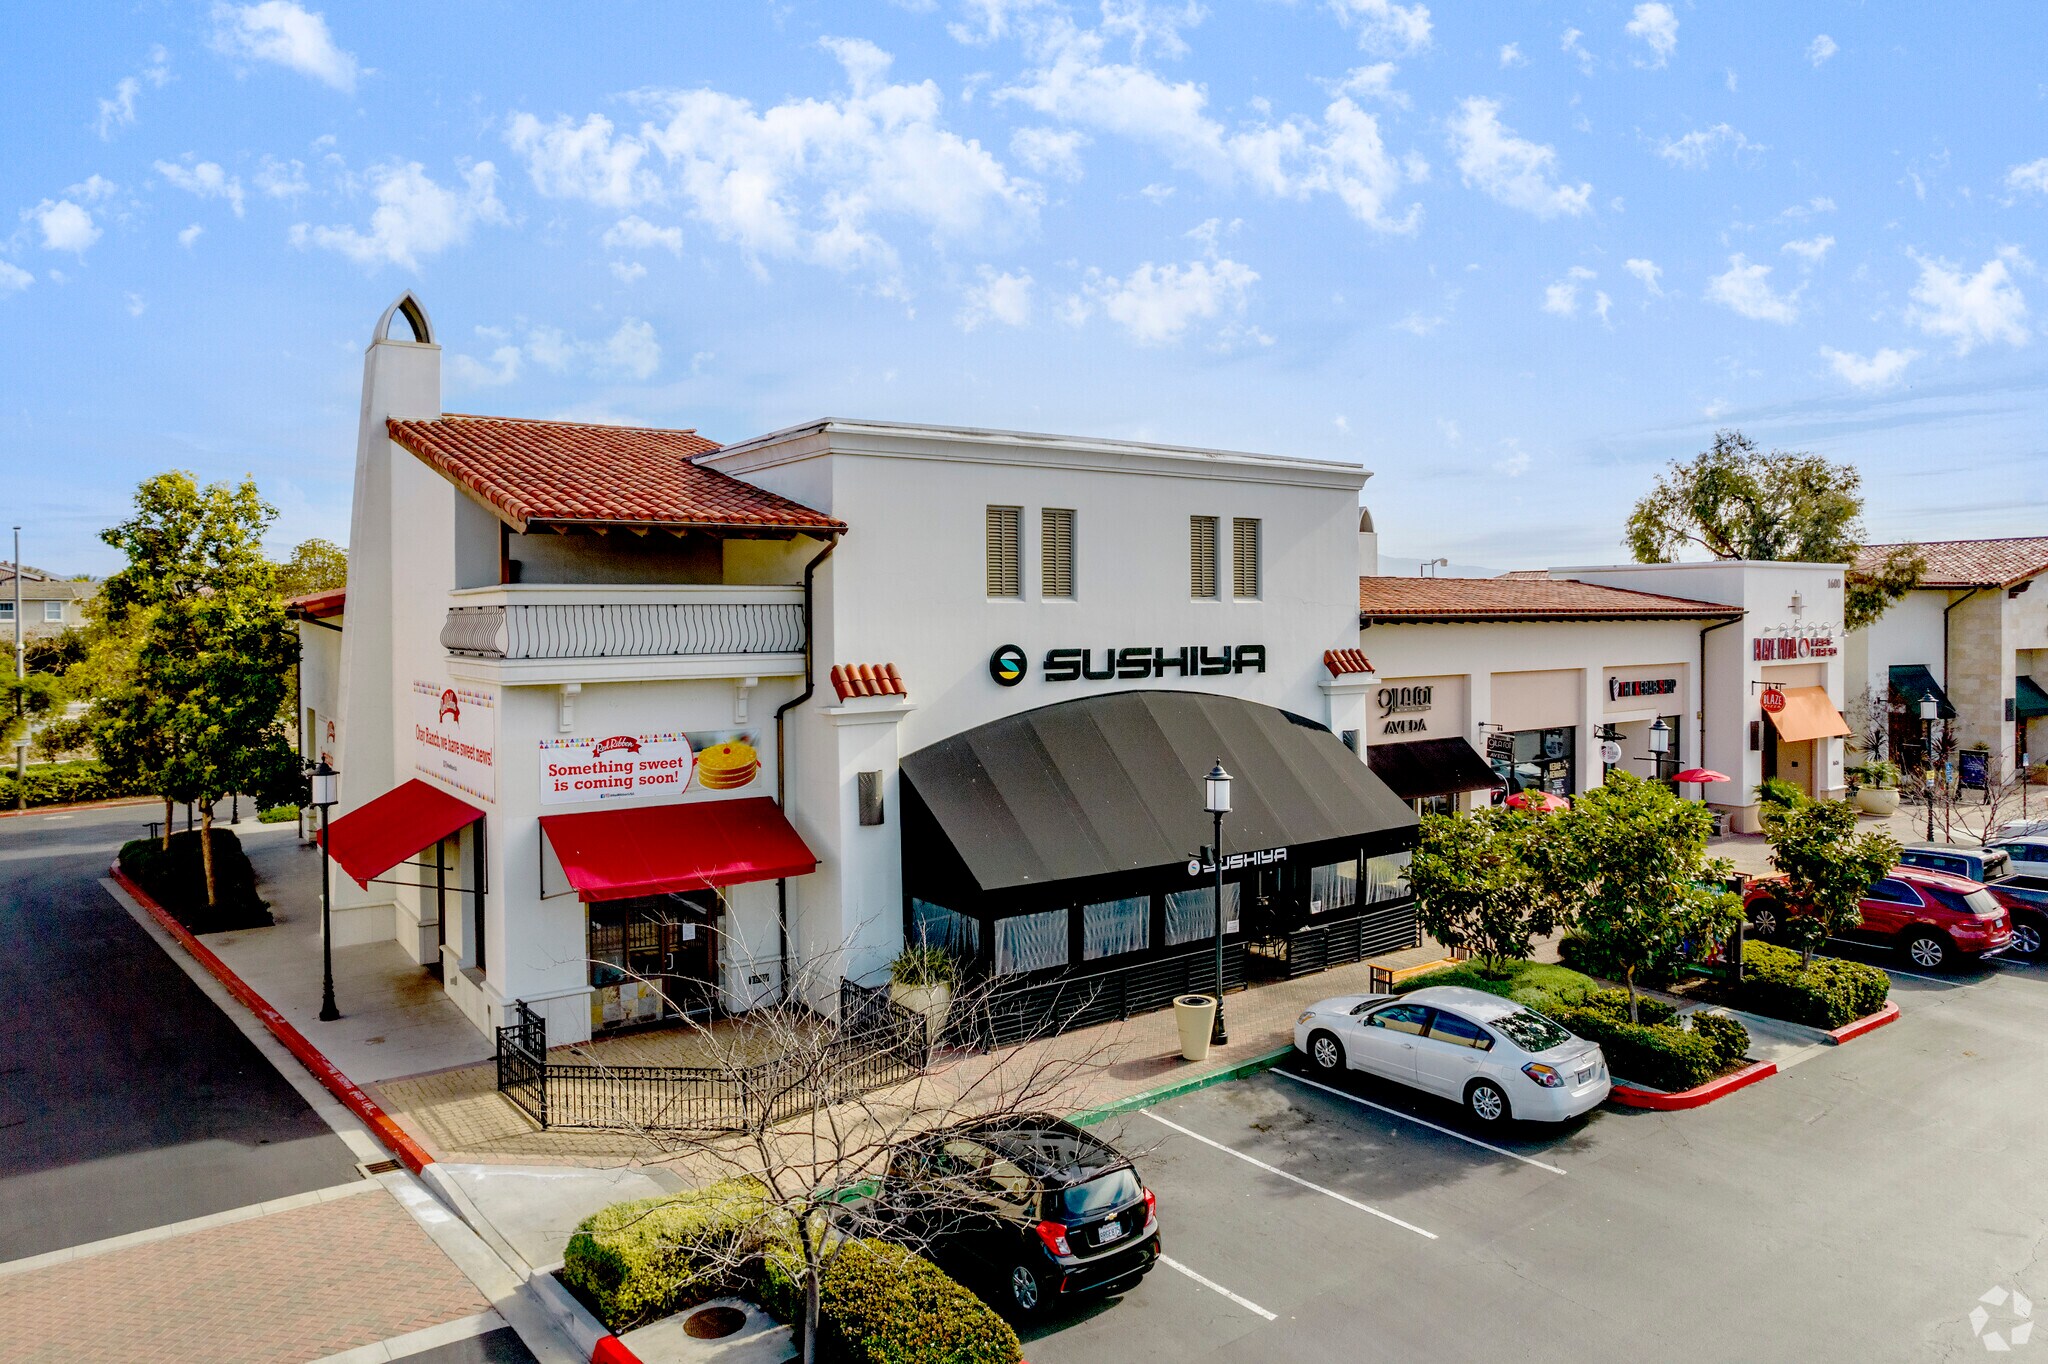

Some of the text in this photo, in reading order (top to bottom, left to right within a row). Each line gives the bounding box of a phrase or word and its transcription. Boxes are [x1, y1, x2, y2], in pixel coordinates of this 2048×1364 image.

[1827, 578, 1841, 589] 1600
[1043, 644, 1266, 682] SUSHIYA
[1635, 680, 1657, 696] KEBAB
[1656, 679, 1677, 695] SHOP
[1763, 693, 1782, 706] BLAZE
[1383, 718, 1427, 735] AVEDA
[596, 737, 635, 754] Red Ribbon
[1489, 752, 1508, 760] AVEDA
[549, 757, 683, 776] Something sweet
[554, 771, 679, 792] is coming soon!
